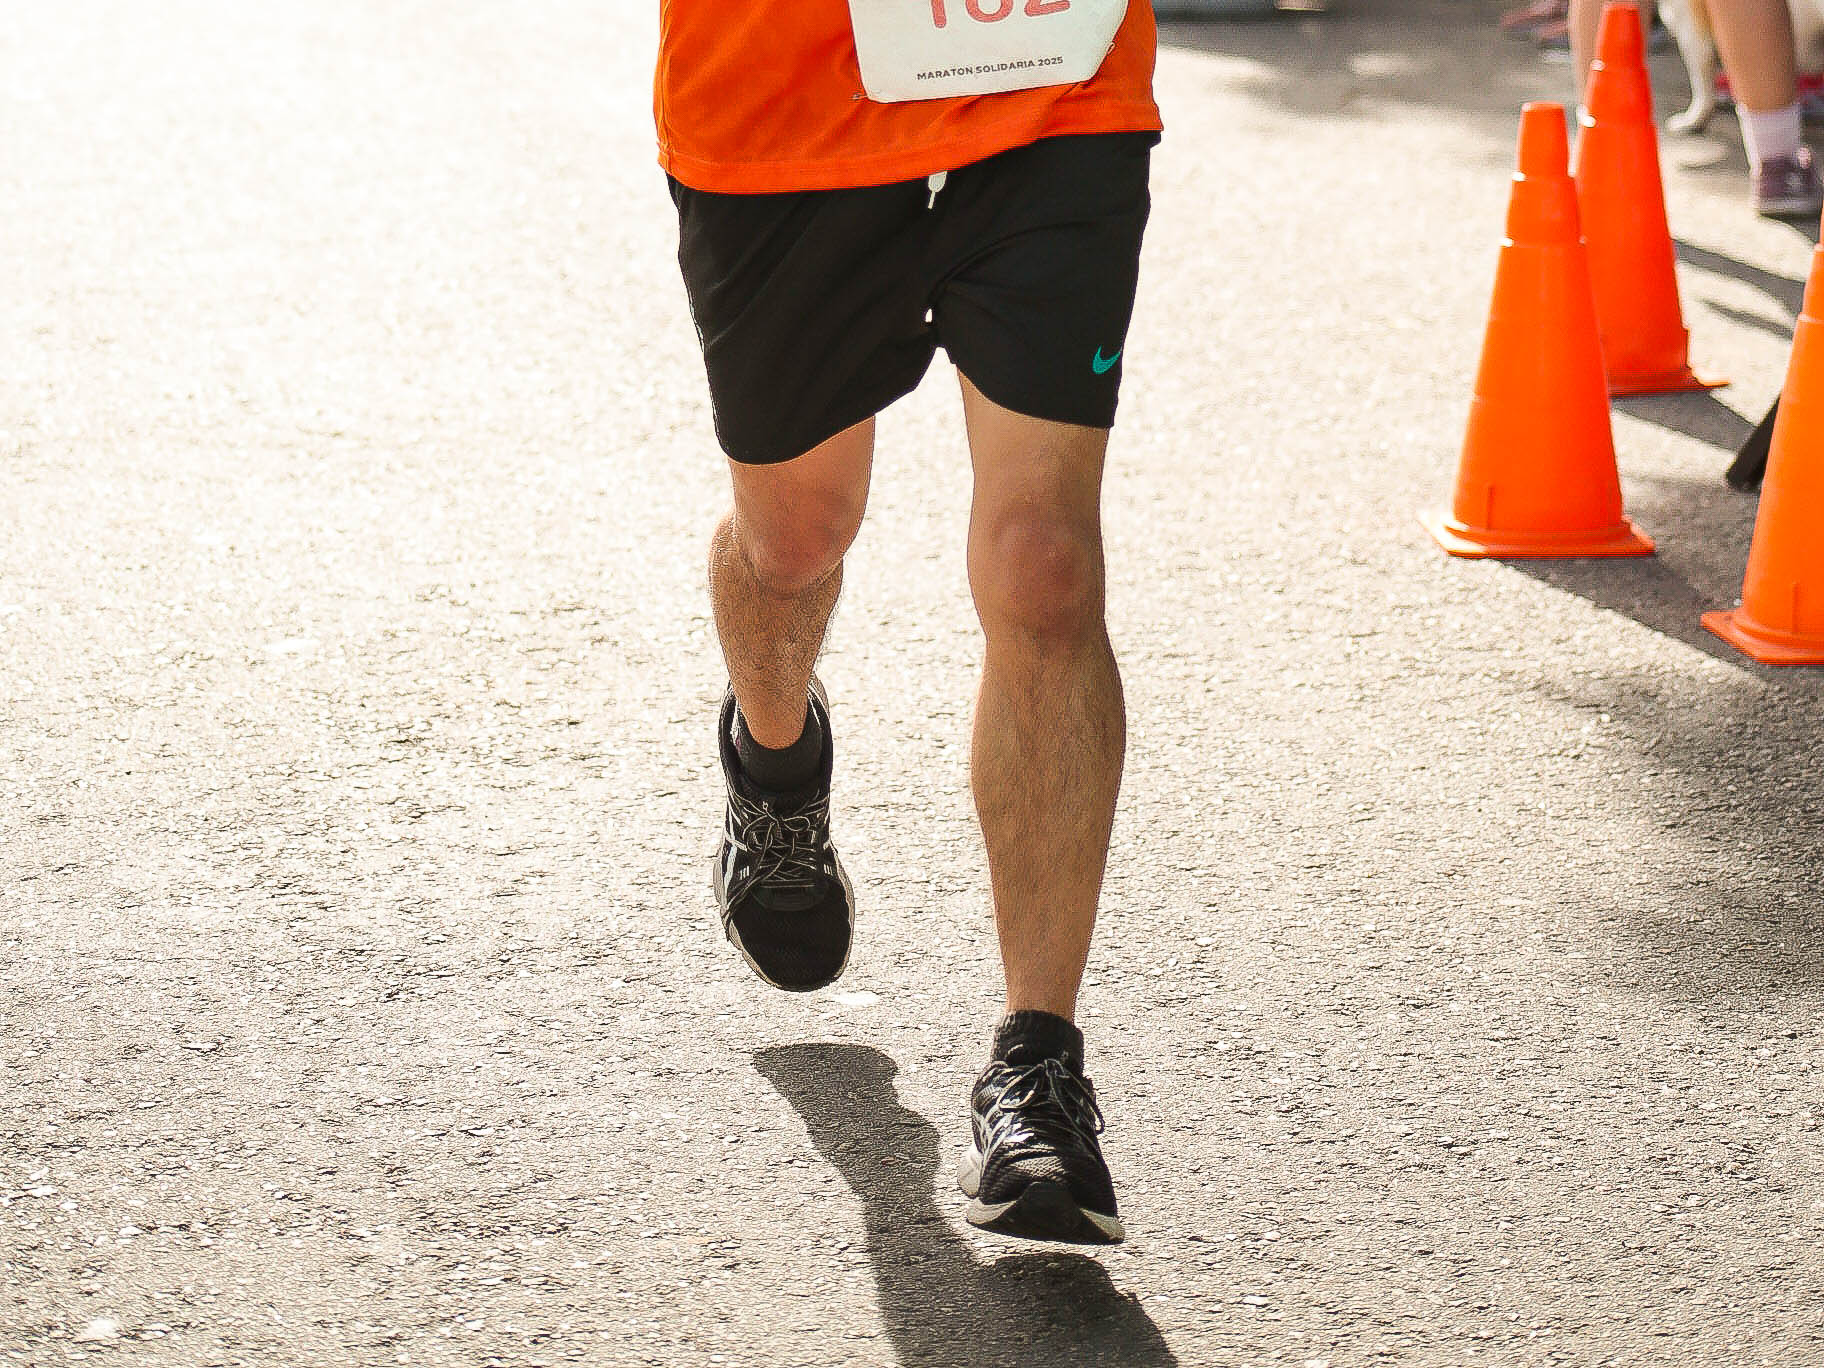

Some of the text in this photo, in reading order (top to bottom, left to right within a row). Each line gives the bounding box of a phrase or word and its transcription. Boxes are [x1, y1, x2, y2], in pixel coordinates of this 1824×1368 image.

[917, 56, 1063, 81] MARATON SOLIDARIA 2025
